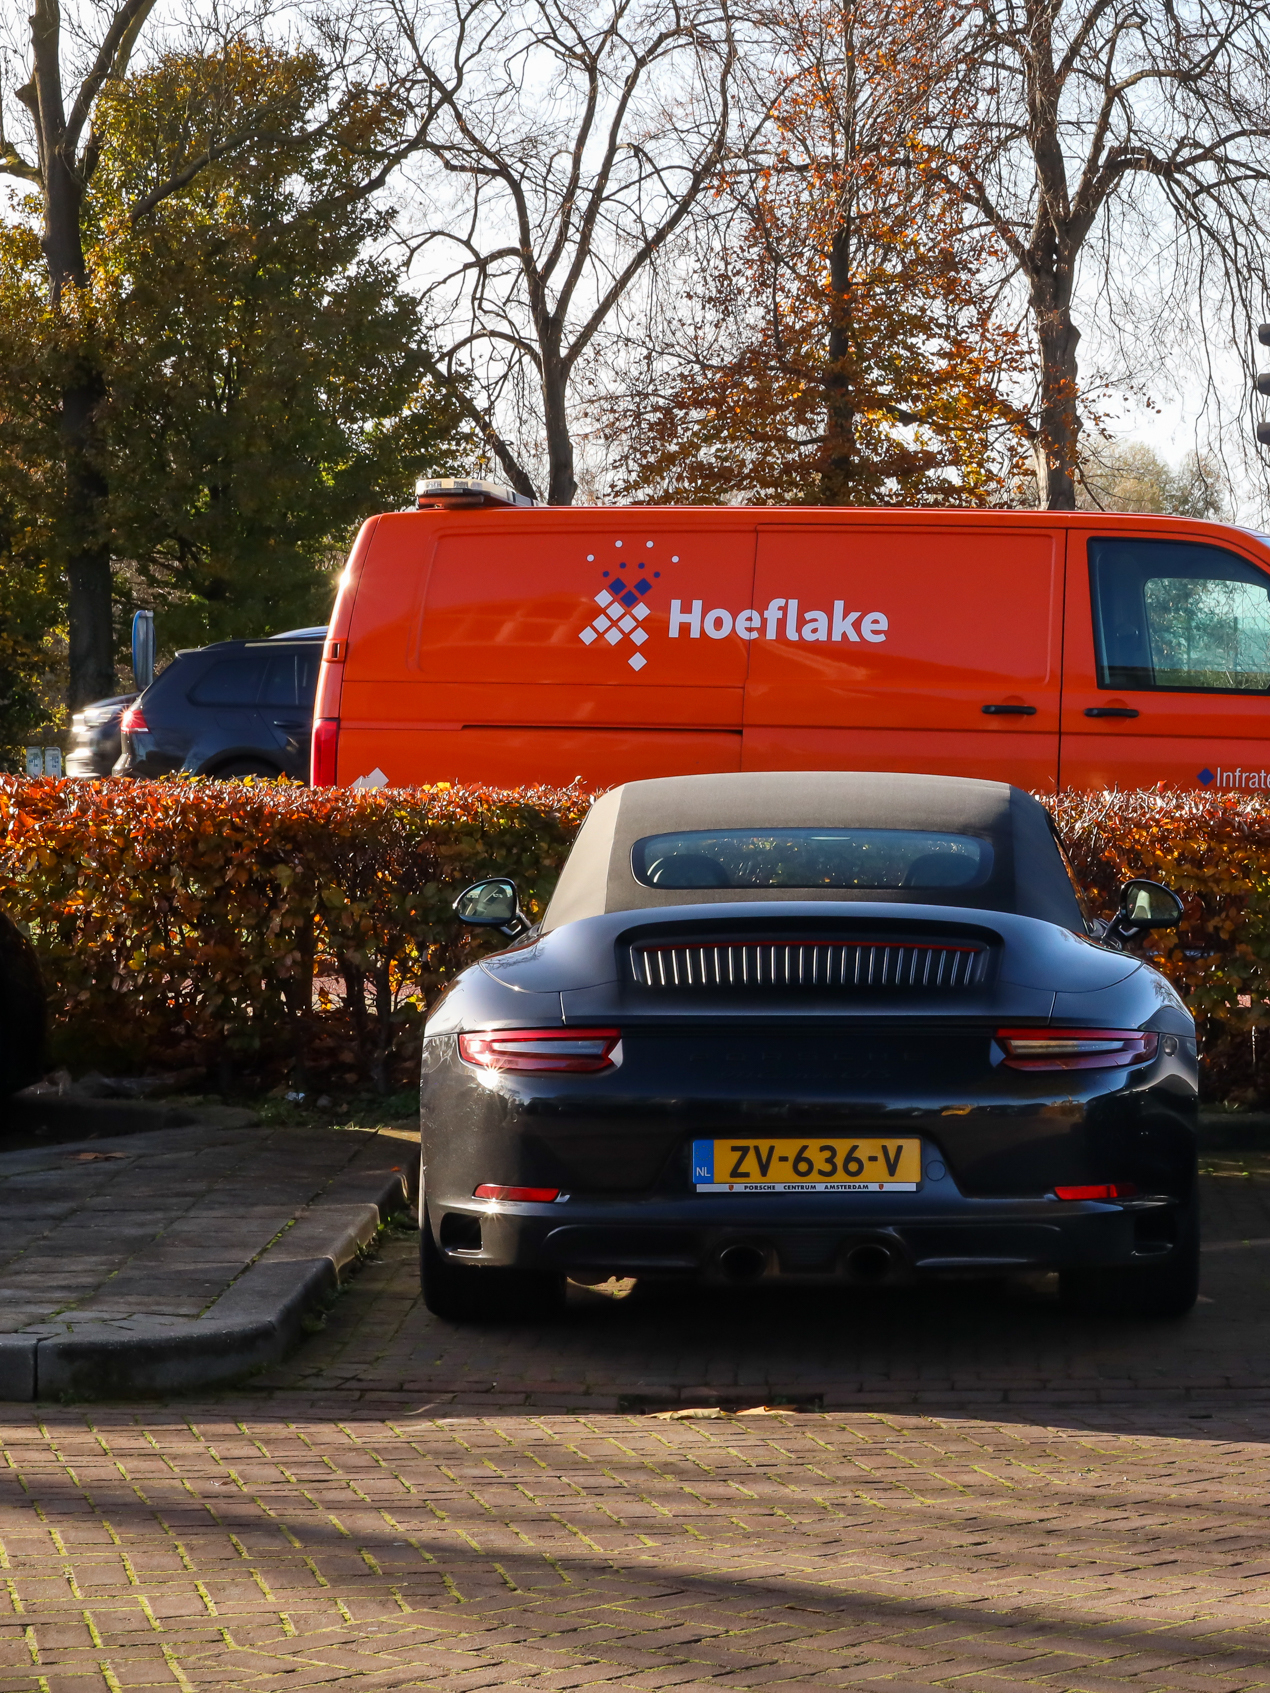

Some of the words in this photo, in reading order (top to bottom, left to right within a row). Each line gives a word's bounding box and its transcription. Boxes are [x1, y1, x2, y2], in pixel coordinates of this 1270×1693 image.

[669, 598, 889, 643] Hoeflake
[696, 1166, 711, 1177] NL
[729, 1144, 904, 1179] ZV-636-V
